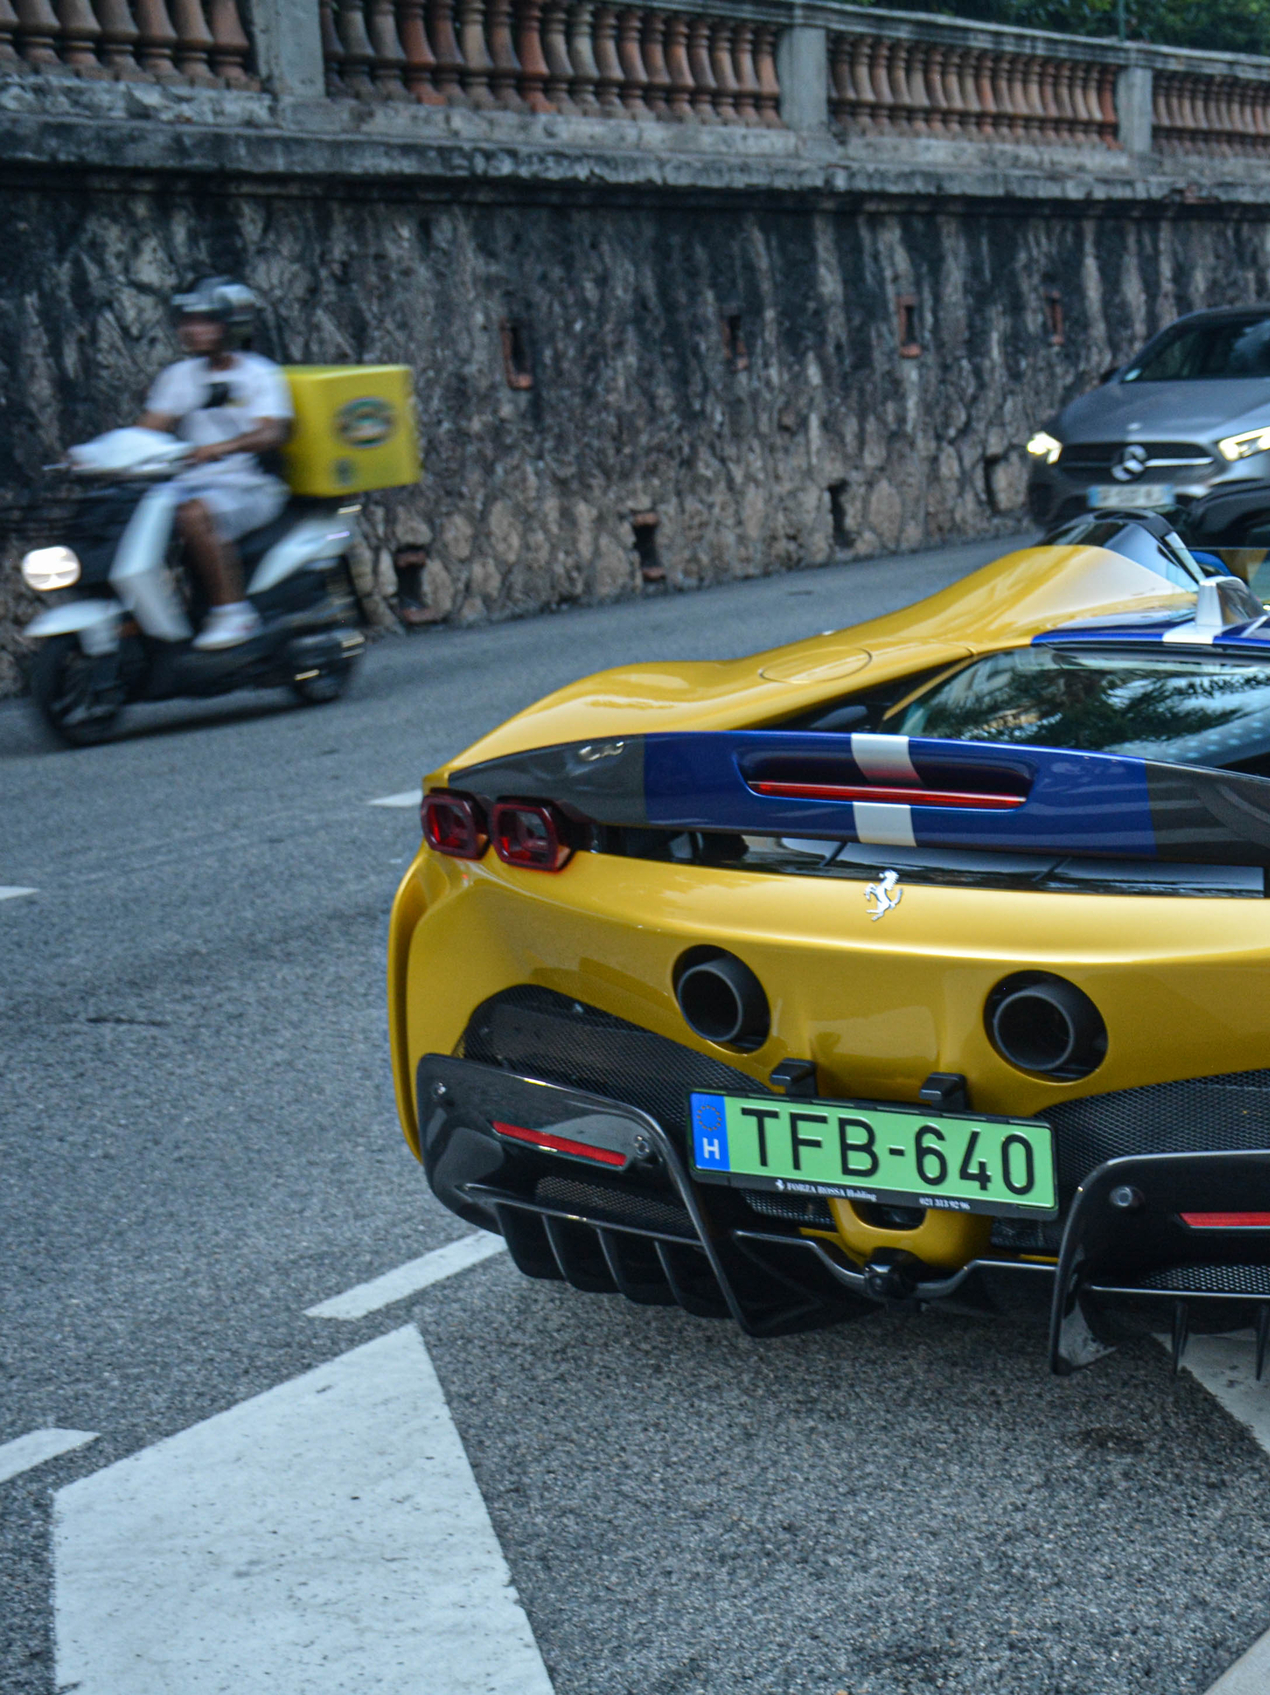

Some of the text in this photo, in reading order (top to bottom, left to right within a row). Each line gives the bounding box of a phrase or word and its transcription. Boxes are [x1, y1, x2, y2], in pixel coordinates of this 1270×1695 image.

[703, 1137, 720, 1160] H
[741, 1106, 1035, 1196] TFB-640
[786, 1182, 877, 1202] FORZA ROSSA Holding
